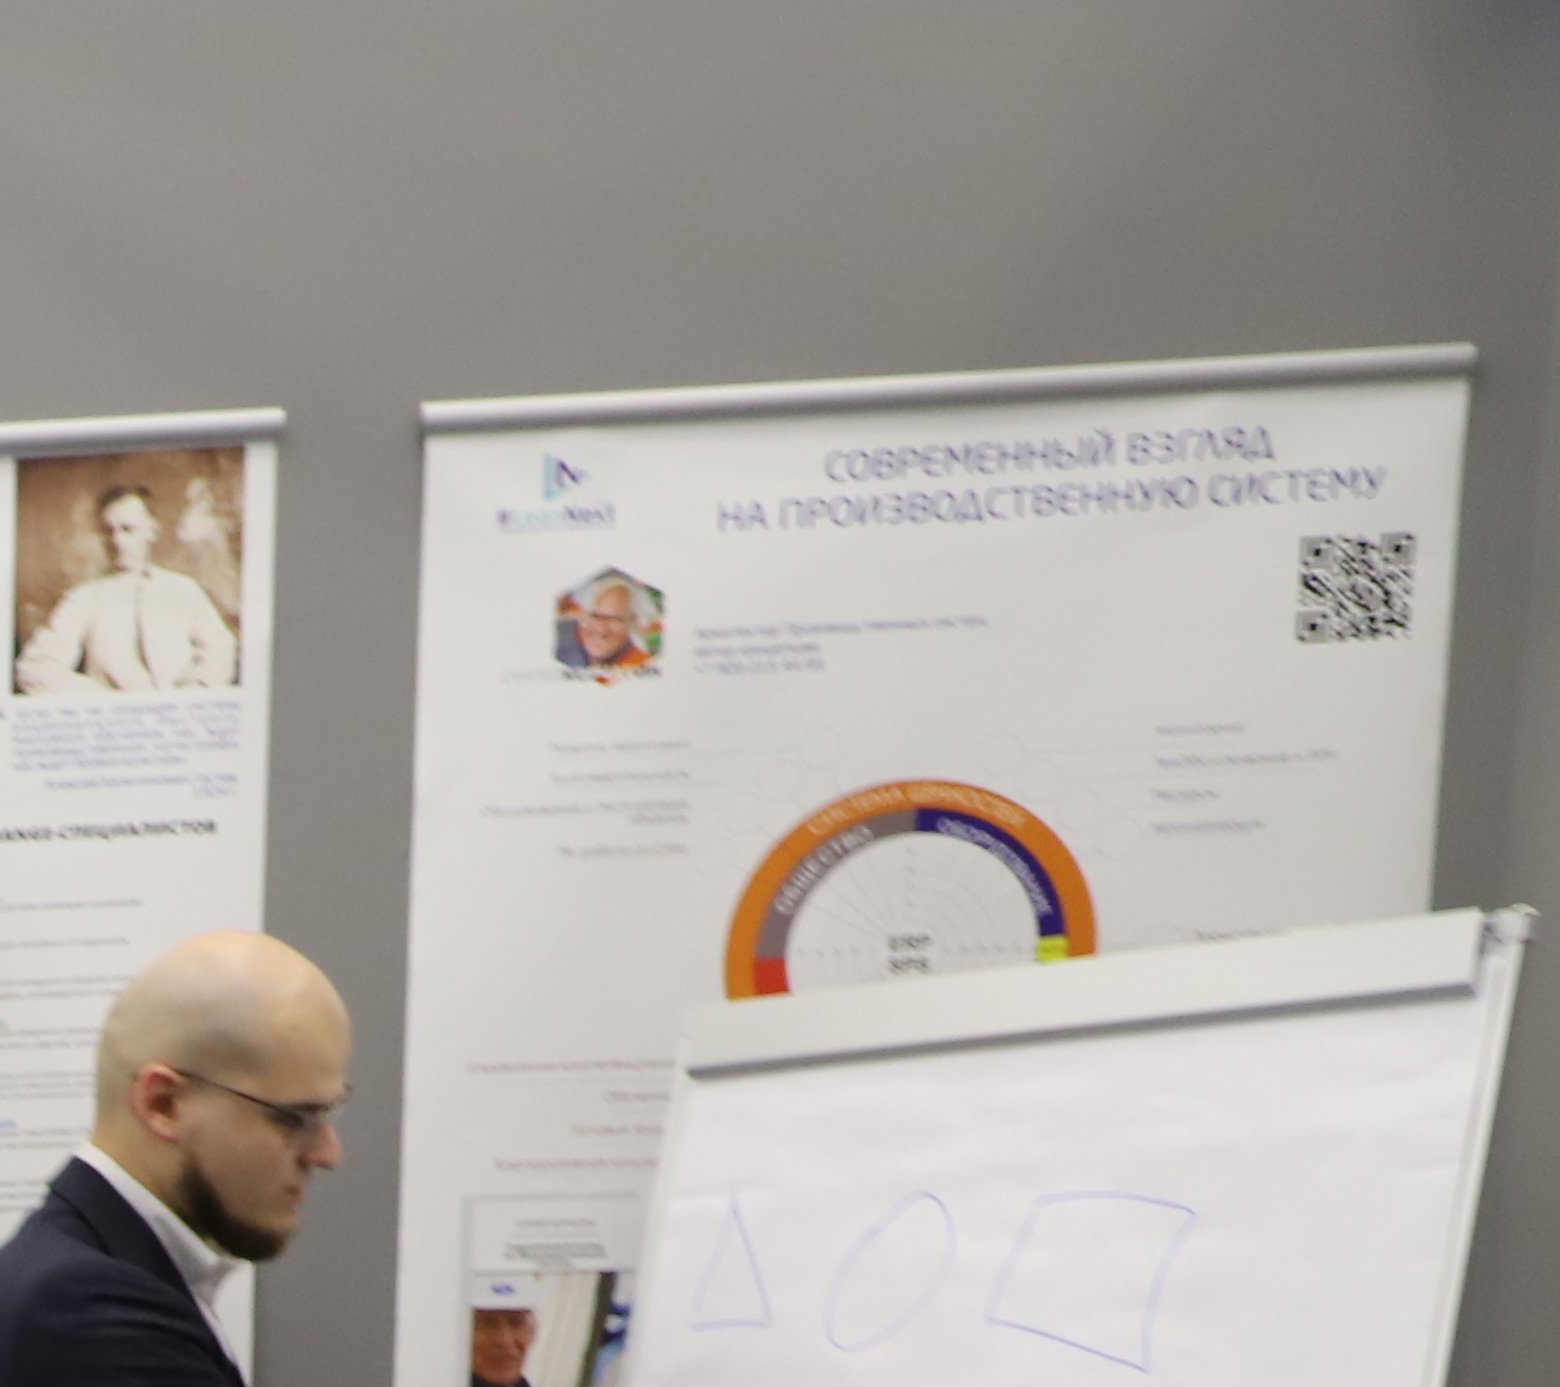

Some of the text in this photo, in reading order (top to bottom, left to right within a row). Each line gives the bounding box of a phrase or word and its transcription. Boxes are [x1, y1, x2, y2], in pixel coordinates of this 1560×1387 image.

[824, 426, 1276, 482] СОВРЕМЕННЫЙ ВЗГЛЯД
[717, 464, 1387, 532] НА ПРОИЗВОДСТВЕННУЮ СИСТЕМУ
